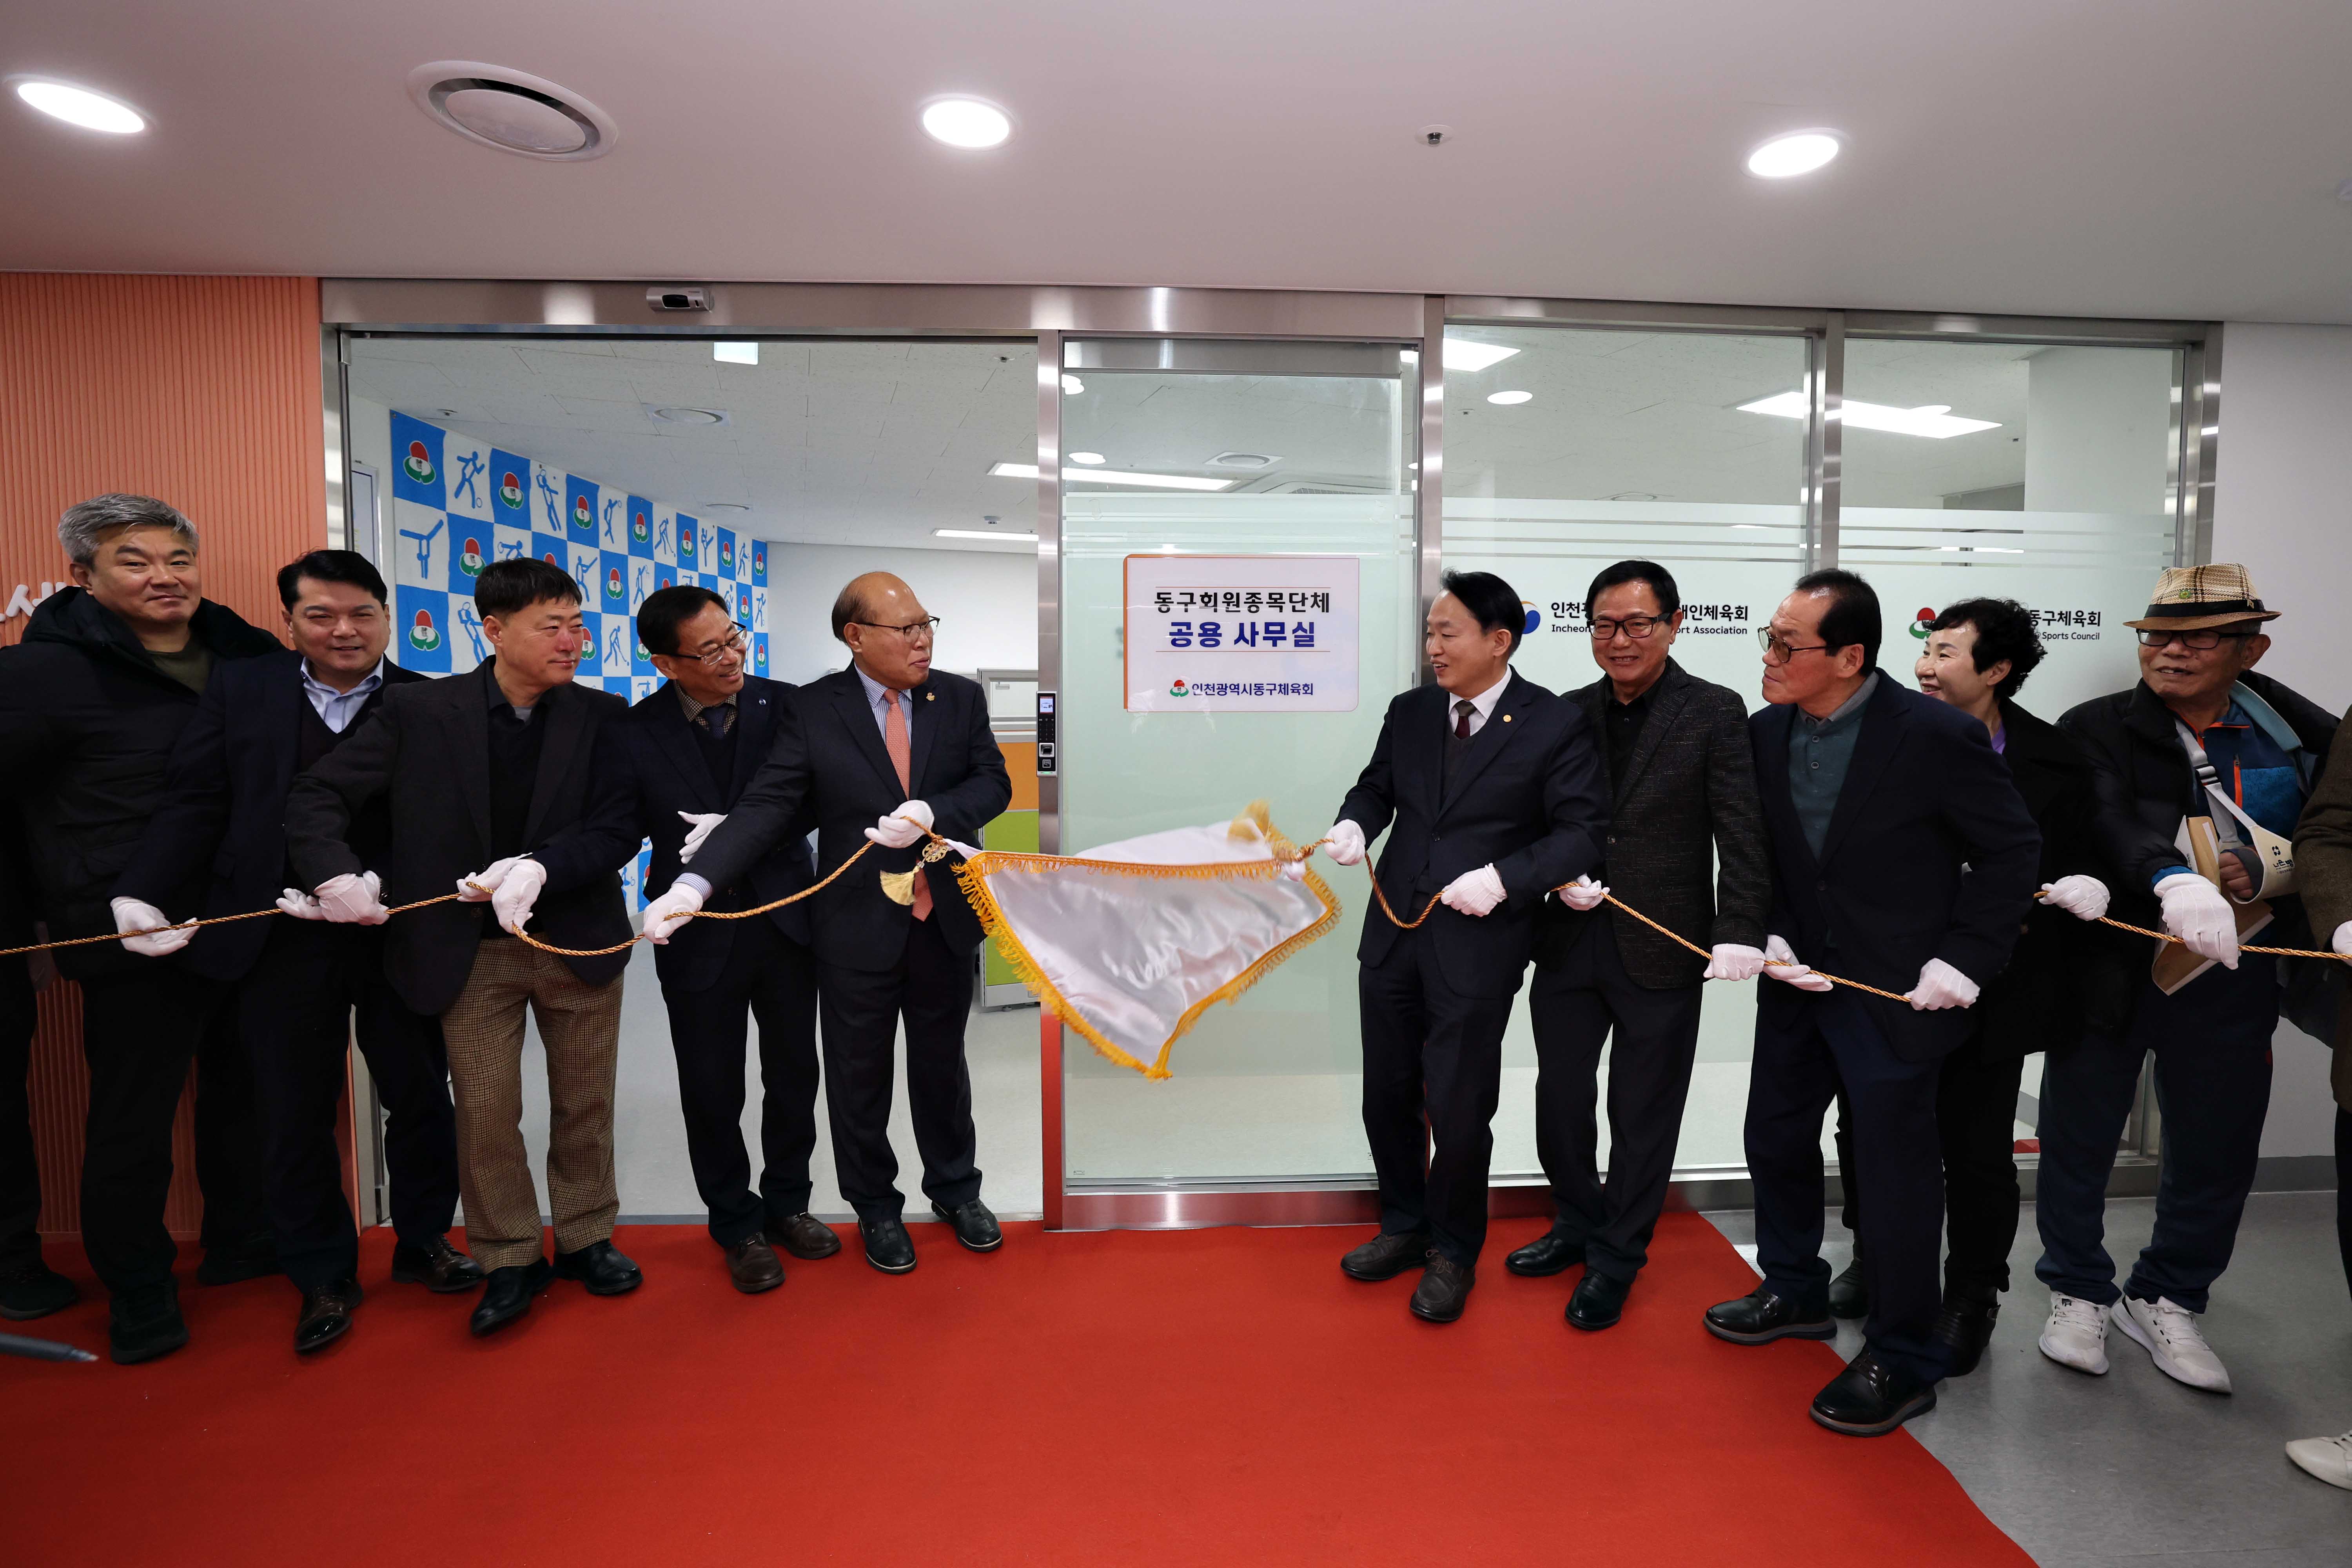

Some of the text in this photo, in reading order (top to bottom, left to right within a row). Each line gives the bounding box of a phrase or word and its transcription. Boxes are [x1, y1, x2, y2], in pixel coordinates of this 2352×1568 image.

[1154, 592, 1329, 613] 동구회원종목단체
[1552, 624, 1590, 632] Incheon
[1169, 622, 1315, 648] 공용 사무실
[2042, 632, 2069, 641] Sports
[1192, 683, 1313, 696] 인천광역시동구체육회
